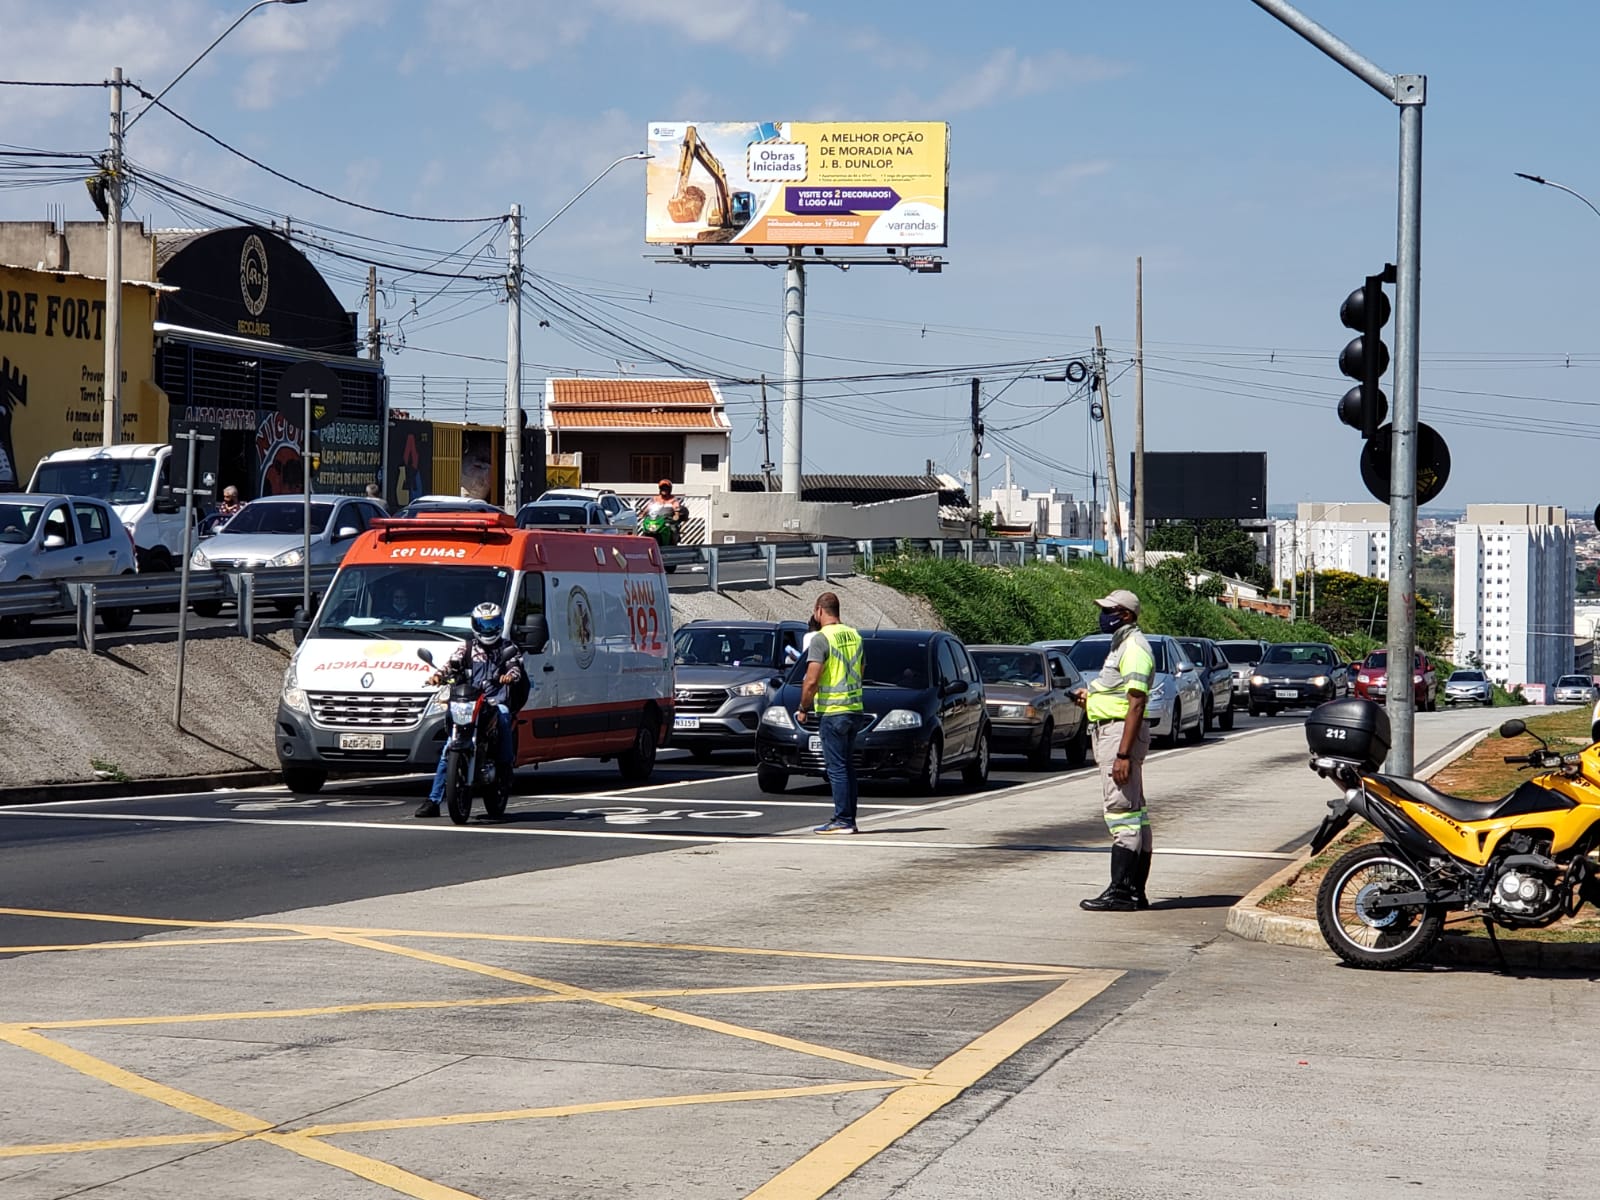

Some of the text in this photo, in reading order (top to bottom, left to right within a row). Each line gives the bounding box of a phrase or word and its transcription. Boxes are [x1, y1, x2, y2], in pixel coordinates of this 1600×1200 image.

[821, 131, 924, 144] A MELHOR OPÇÃO
[760, 150, 795, 161] Obras
[820, 146, 914, 156] DE MORADIA NA
[753, 162, 801, 172] Iniciadas
[820, 159, 893, 169] J. B. DUNLOP.
[834, 189, 841, 198] 2
[798, 198, 803, 206] É
[888, 219, 937, 231] varandas
[45, 295, 106, 340] FORT
[624, 579, 655, 605] SAMU
[627, 607, 661, 651] 192
[1326, 728, 1346, 740] 212
